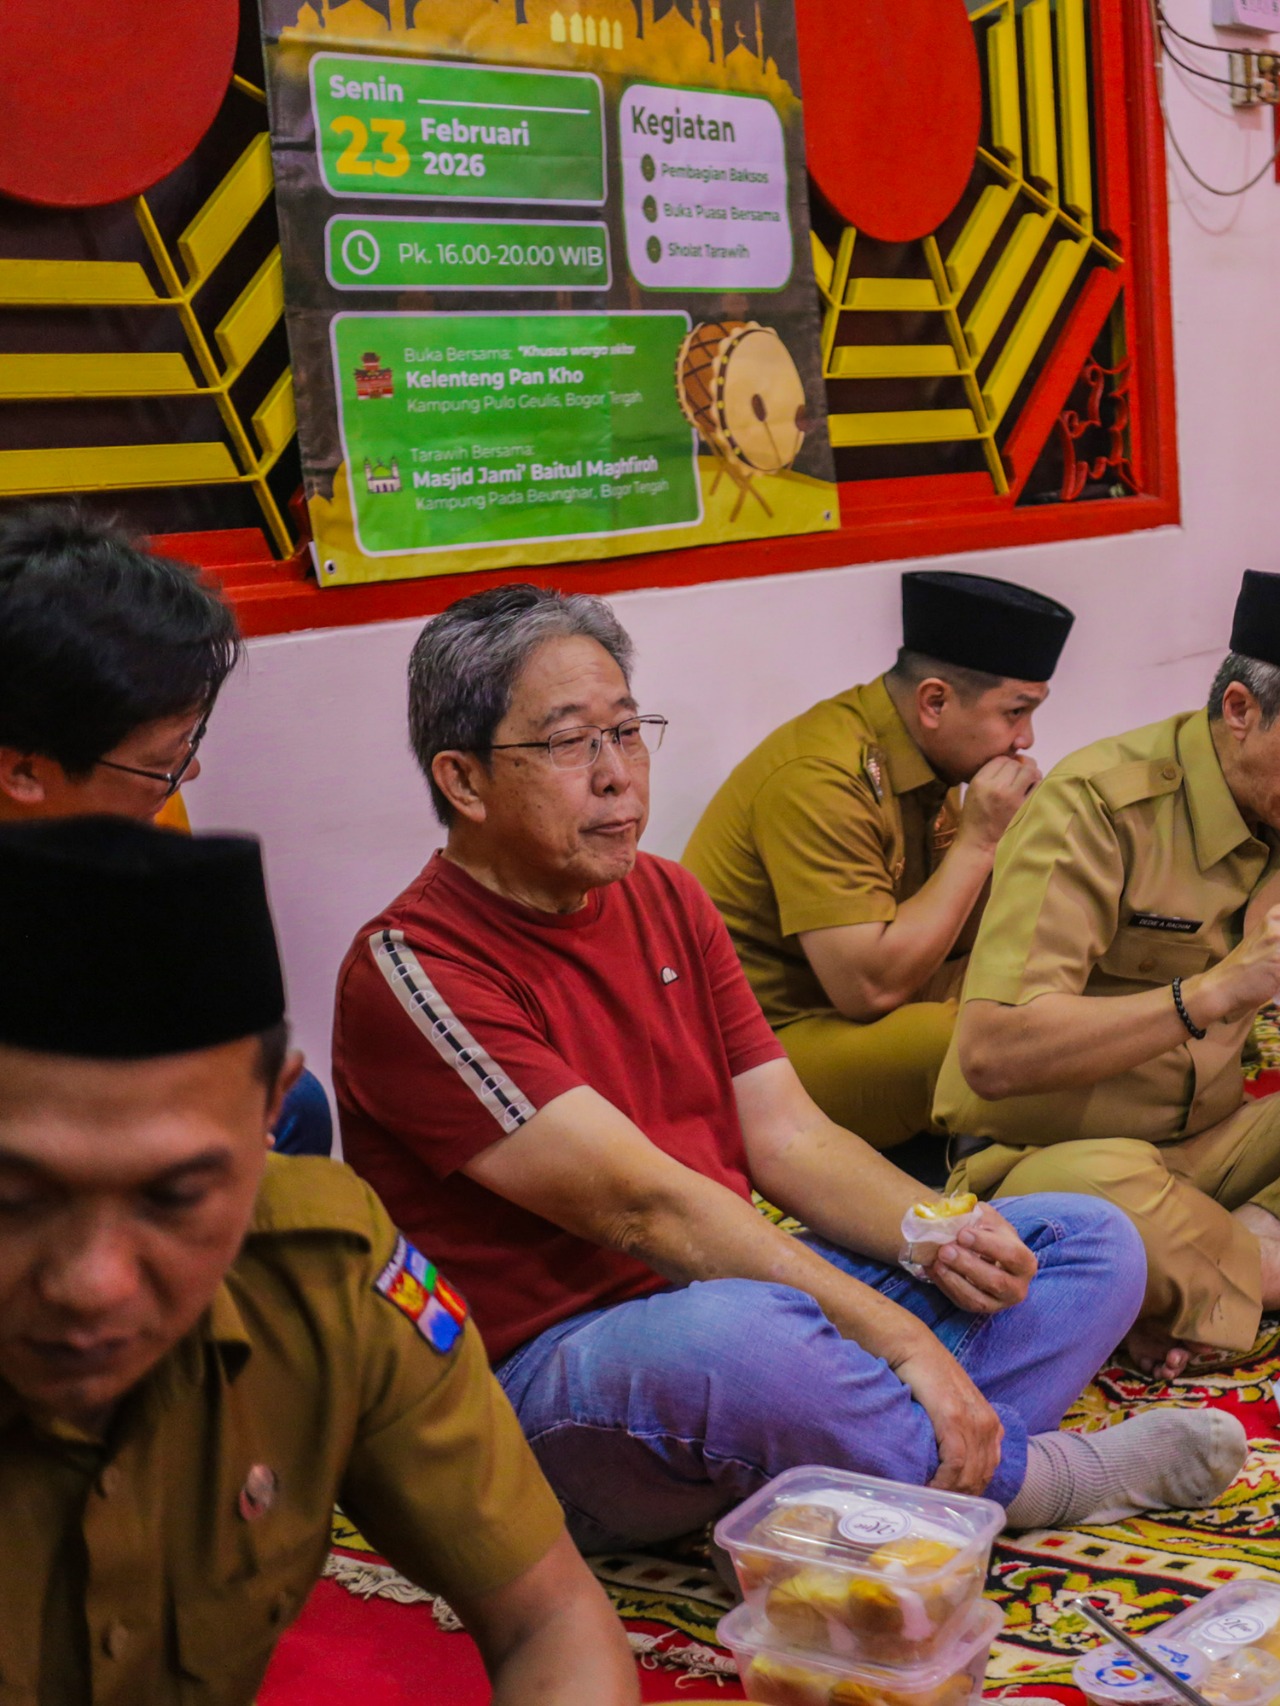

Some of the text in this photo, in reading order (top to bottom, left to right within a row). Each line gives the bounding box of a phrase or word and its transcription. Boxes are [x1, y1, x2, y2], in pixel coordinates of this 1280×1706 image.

[329, 75, 404, 102] Senin
[420, 117, 530, 146] Februari
[631, 105, 736, 145] Kegiatan
[329, 115, 411, 177] 23
[422, 152, 486, 177] 2026
[661, 162, 769, 184] Pembagian Baksos
[663, 203, 693, 218] Buka
[730, 207, 781, 222] Bersama
[398, 242, 604, 267] Pk. 16.00-20.00 WIB
[668, 242, 750, 258] Sholat Tarawih
[404, 347, 443, 362] Buka
[406, 366, 584, 390] Kelenteng Pan Kho
[407, 398, 481, 414] Kampung
[483, 395, 516, 410] Pulo
[565, 392, 606, 409] Bogor
[410, 447, 469, 462] Tarawih
[412, 467, 474, 491] Masjid
[530, 460, 582, 481] Baitul
[416, 495, 487, 511] Kampung
[488, 490, 524, 505] Pada
